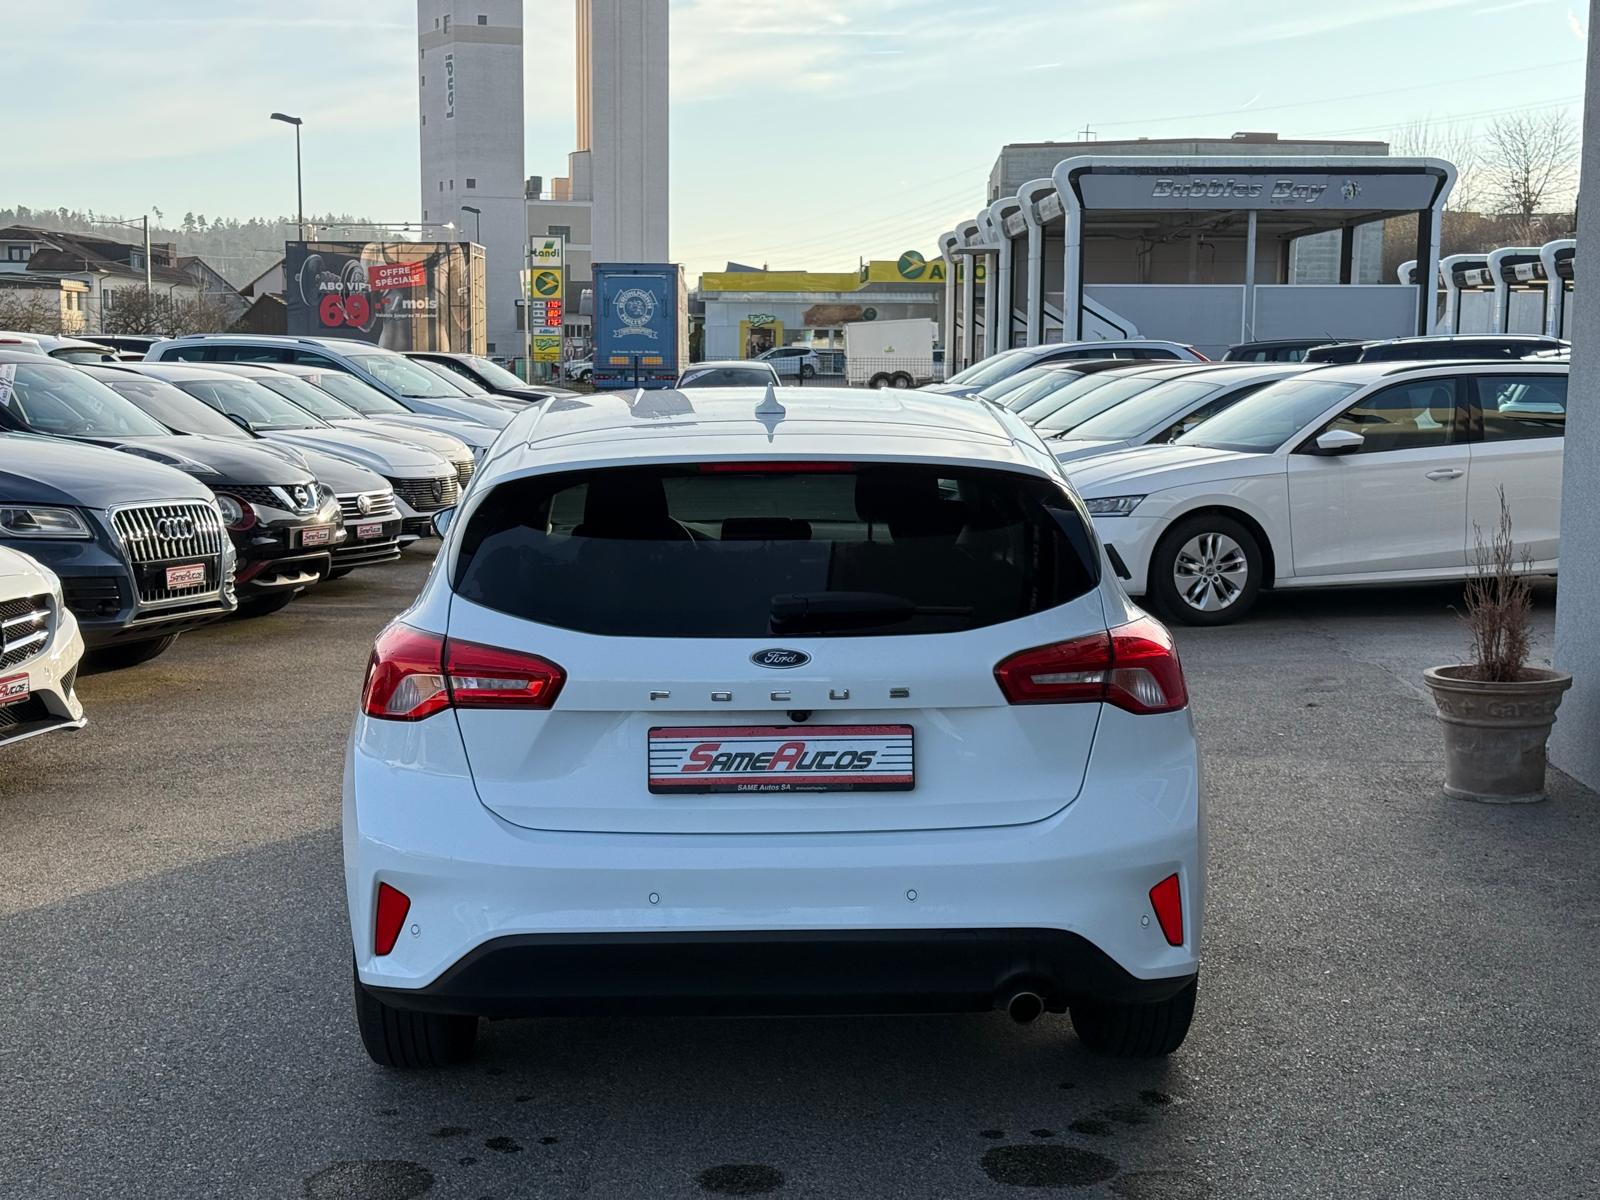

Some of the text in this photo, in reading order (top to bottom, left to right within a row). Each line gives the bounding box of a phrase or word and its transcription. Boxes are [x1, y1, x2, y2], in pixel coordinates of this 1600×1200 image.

[445, 54, 454, 118] Landi
[1152, 178, 1328, 203] Bubbles Bay
[379, 266, 411, 278] OFFRE
[319, 282, 344, 291] ABO
[375, 274, 420, 287] SPÉCIALE
[402, 296, 438, 309] mois
[650, 687, 910, 701] FOCUS
